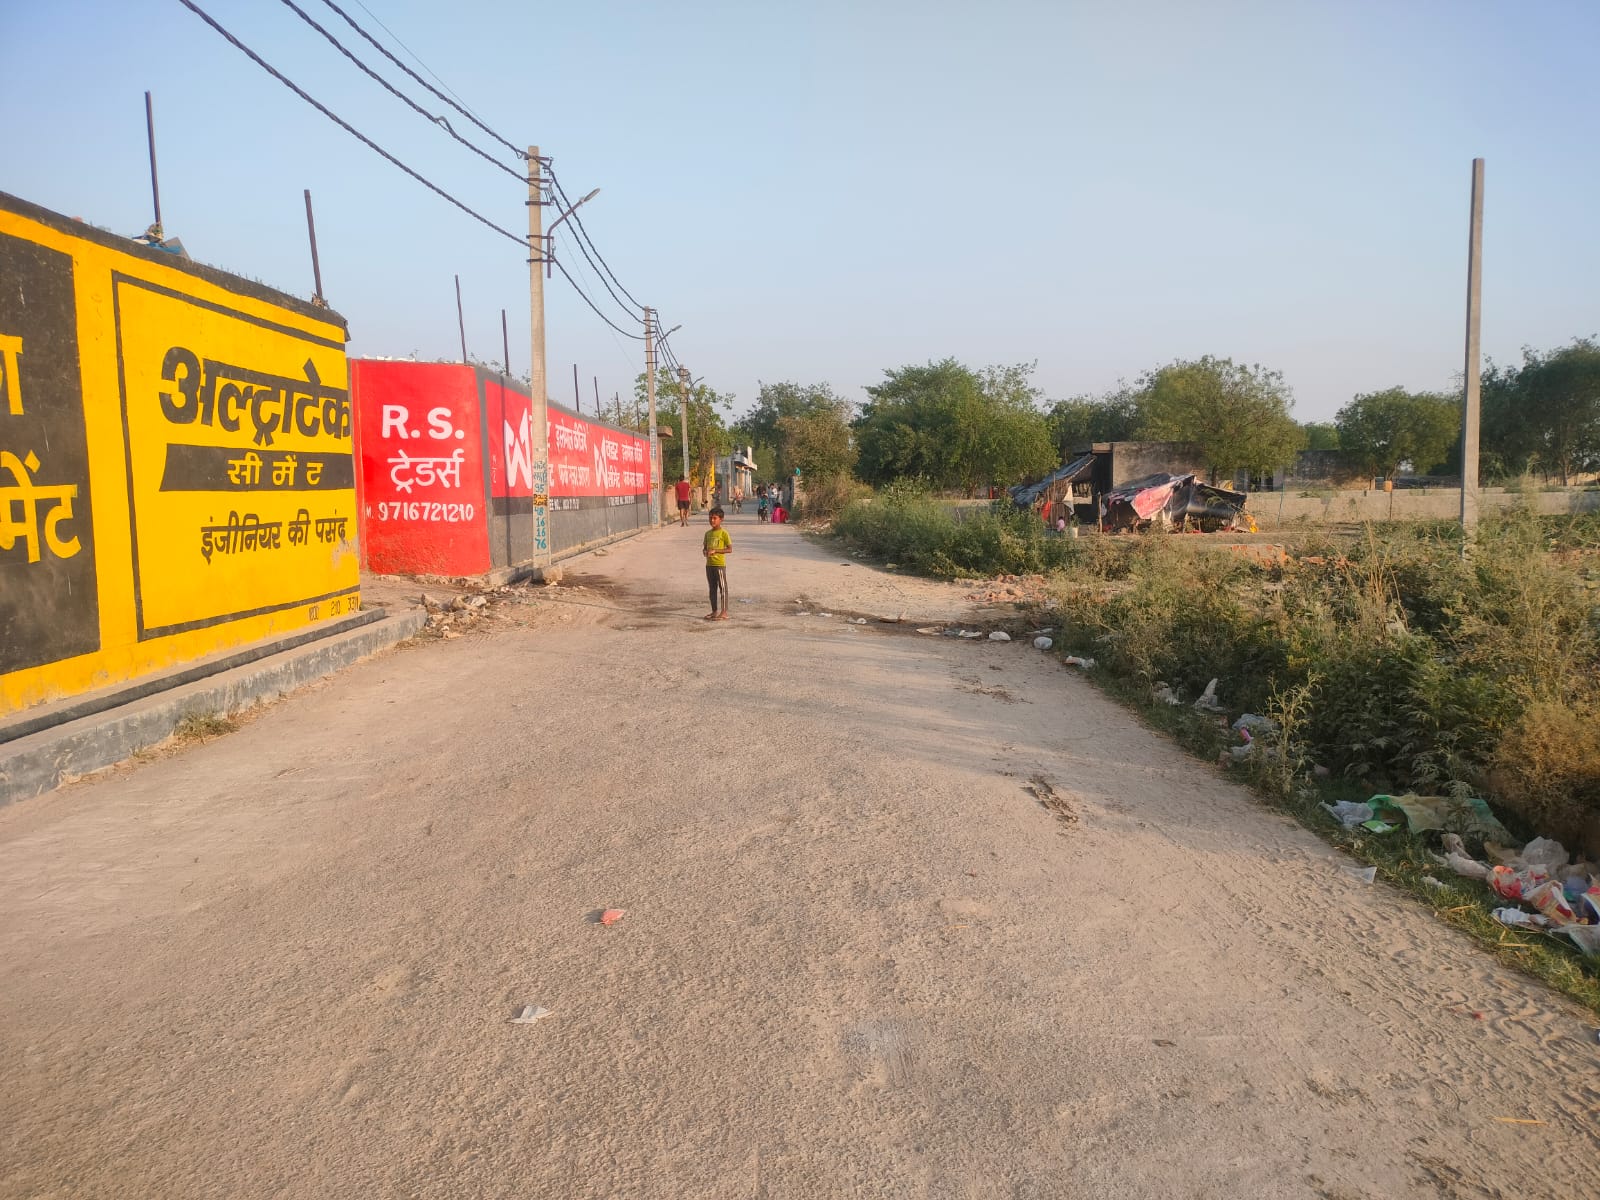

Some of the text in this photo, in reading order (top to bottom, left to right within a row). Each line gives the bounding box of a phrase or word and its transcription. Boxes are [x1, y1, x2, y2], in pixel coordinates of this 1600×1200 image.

[159, 346, 351, 446] अल्ट्राटेक
[382, 404, 465, 440] R.S.
[387, 448, 465, 494] ट्रेडर्स
[378, 501, 474, 523] 9716721210
[201, 508, 348, 565] इंजीनियर की पसंद
